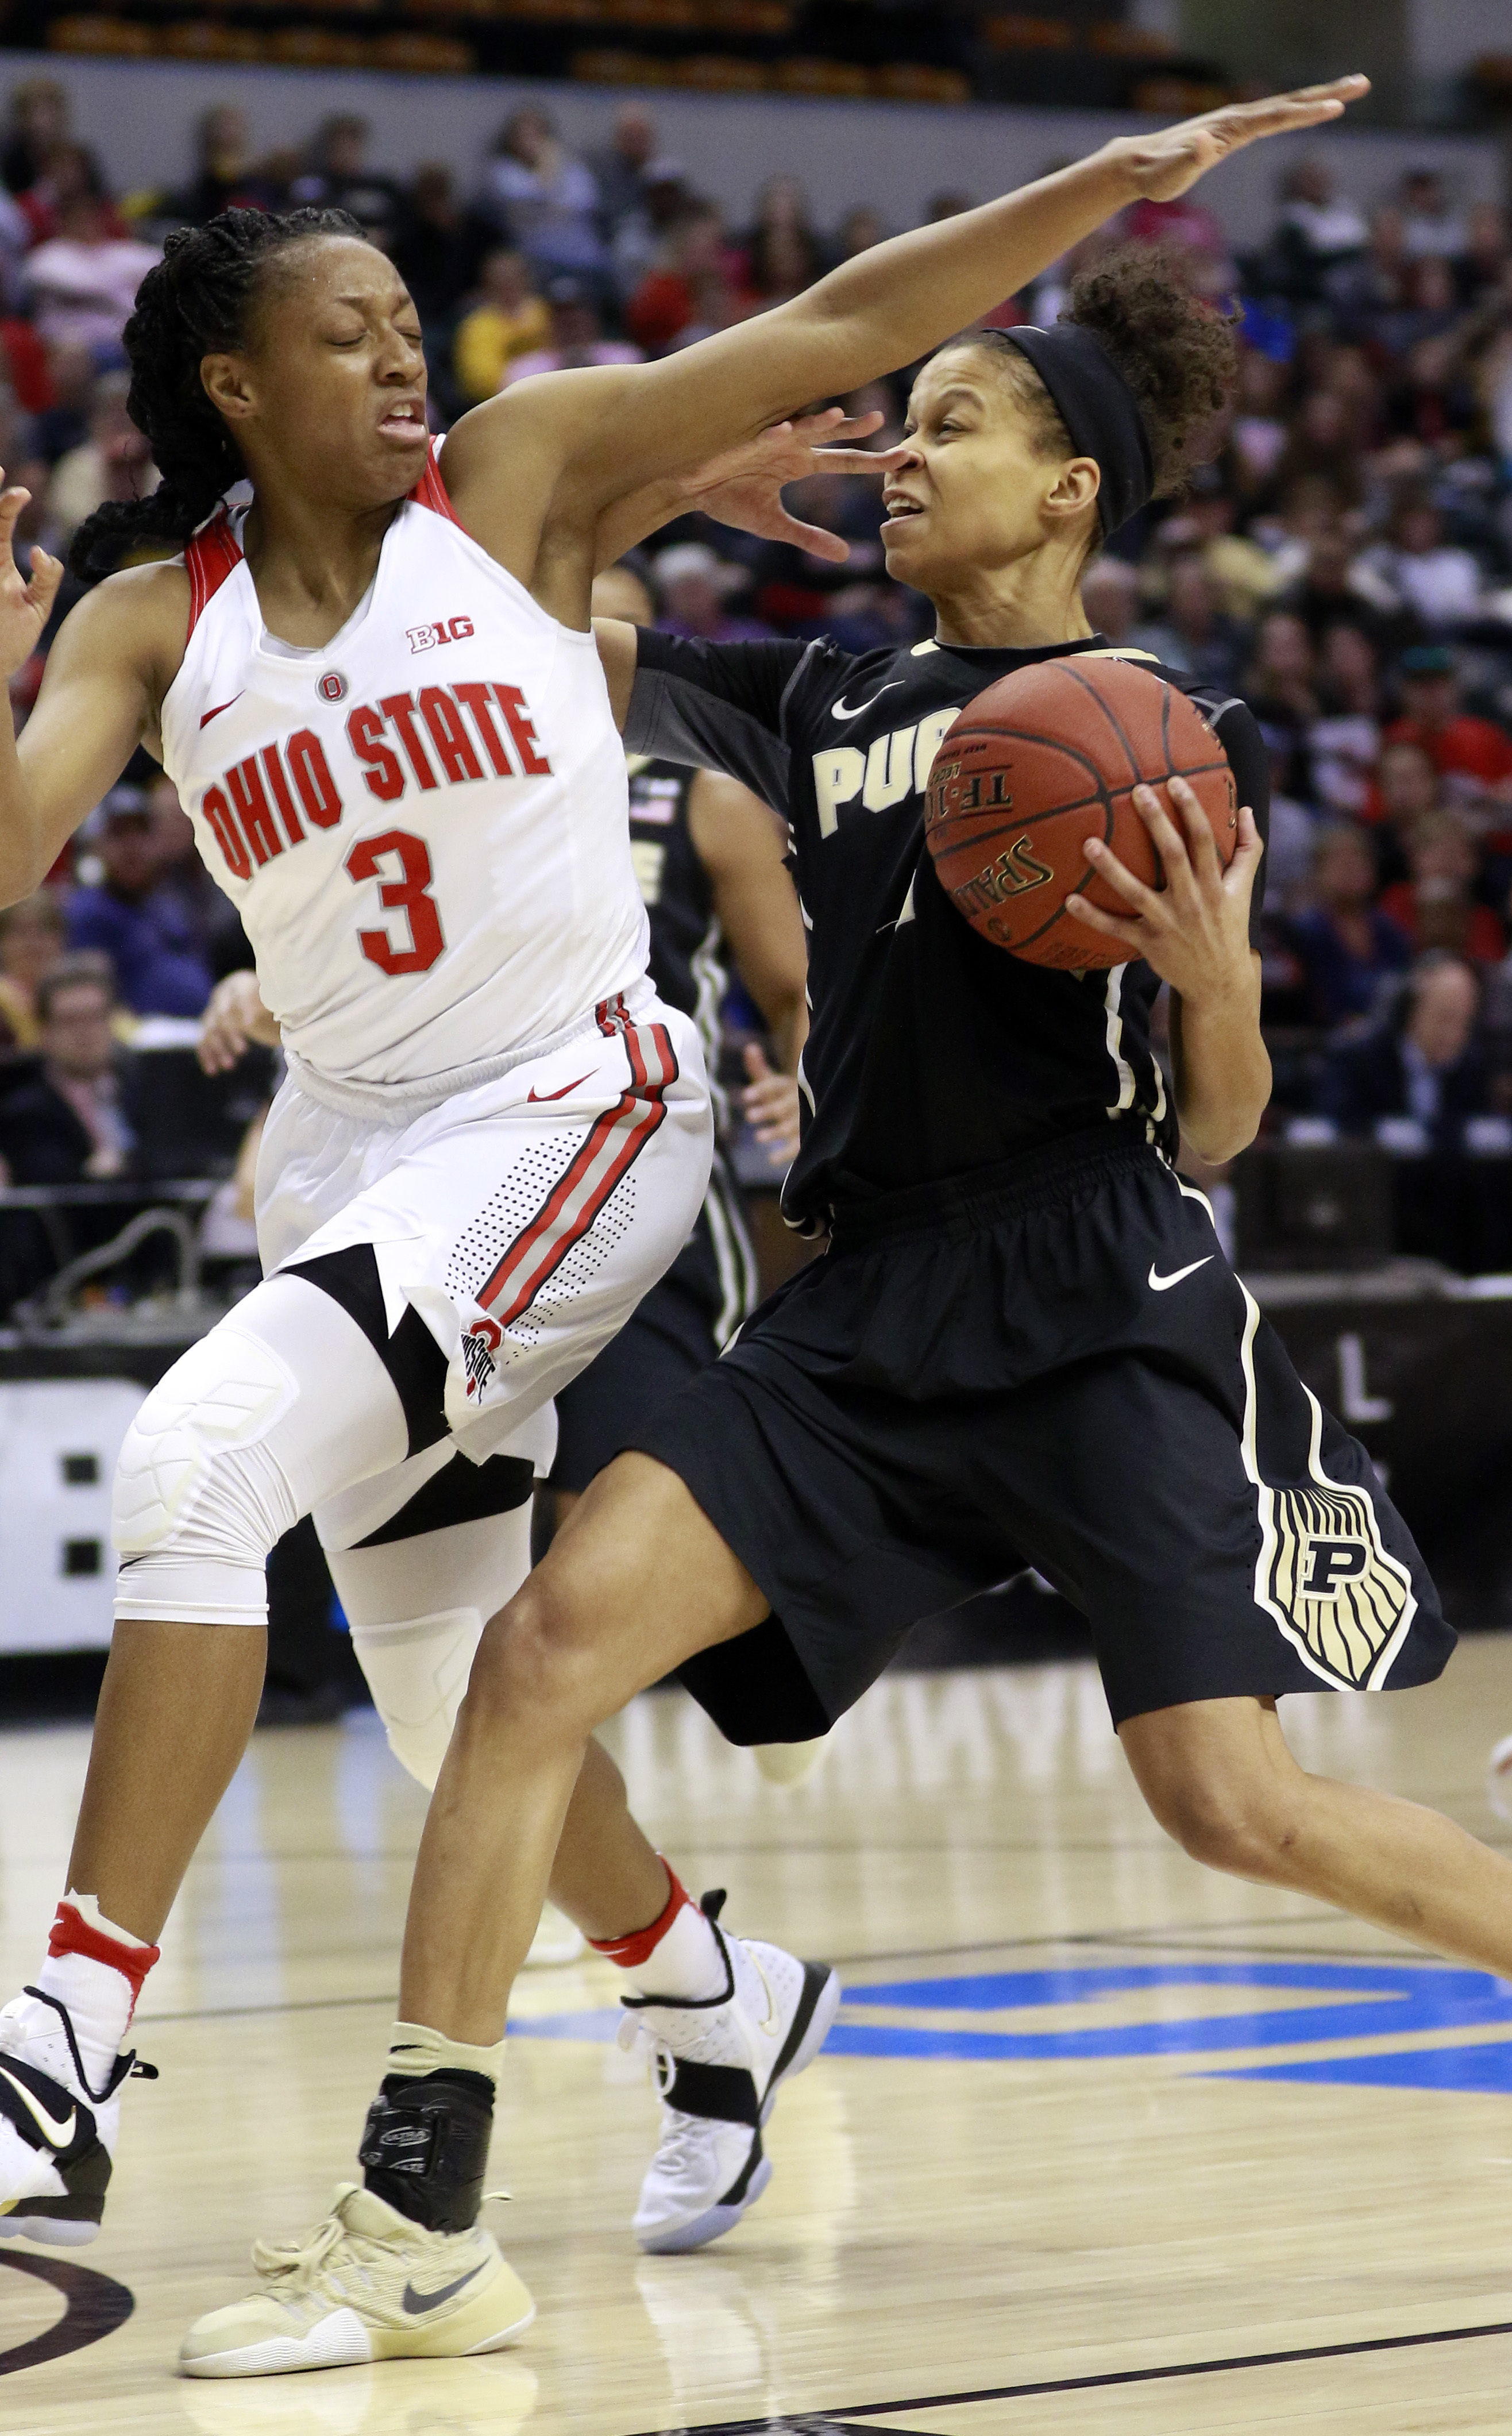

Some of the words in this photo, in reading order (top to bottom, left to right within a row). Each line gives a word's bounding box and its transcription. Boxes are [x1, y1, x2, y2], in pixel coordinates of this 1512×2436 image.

[201, 727, 342, 881] OHIO
[346, 681, 555, 801] STATE
[344, 827, 447, 978] 3
[1299, 1536, 1369, 1598] P
